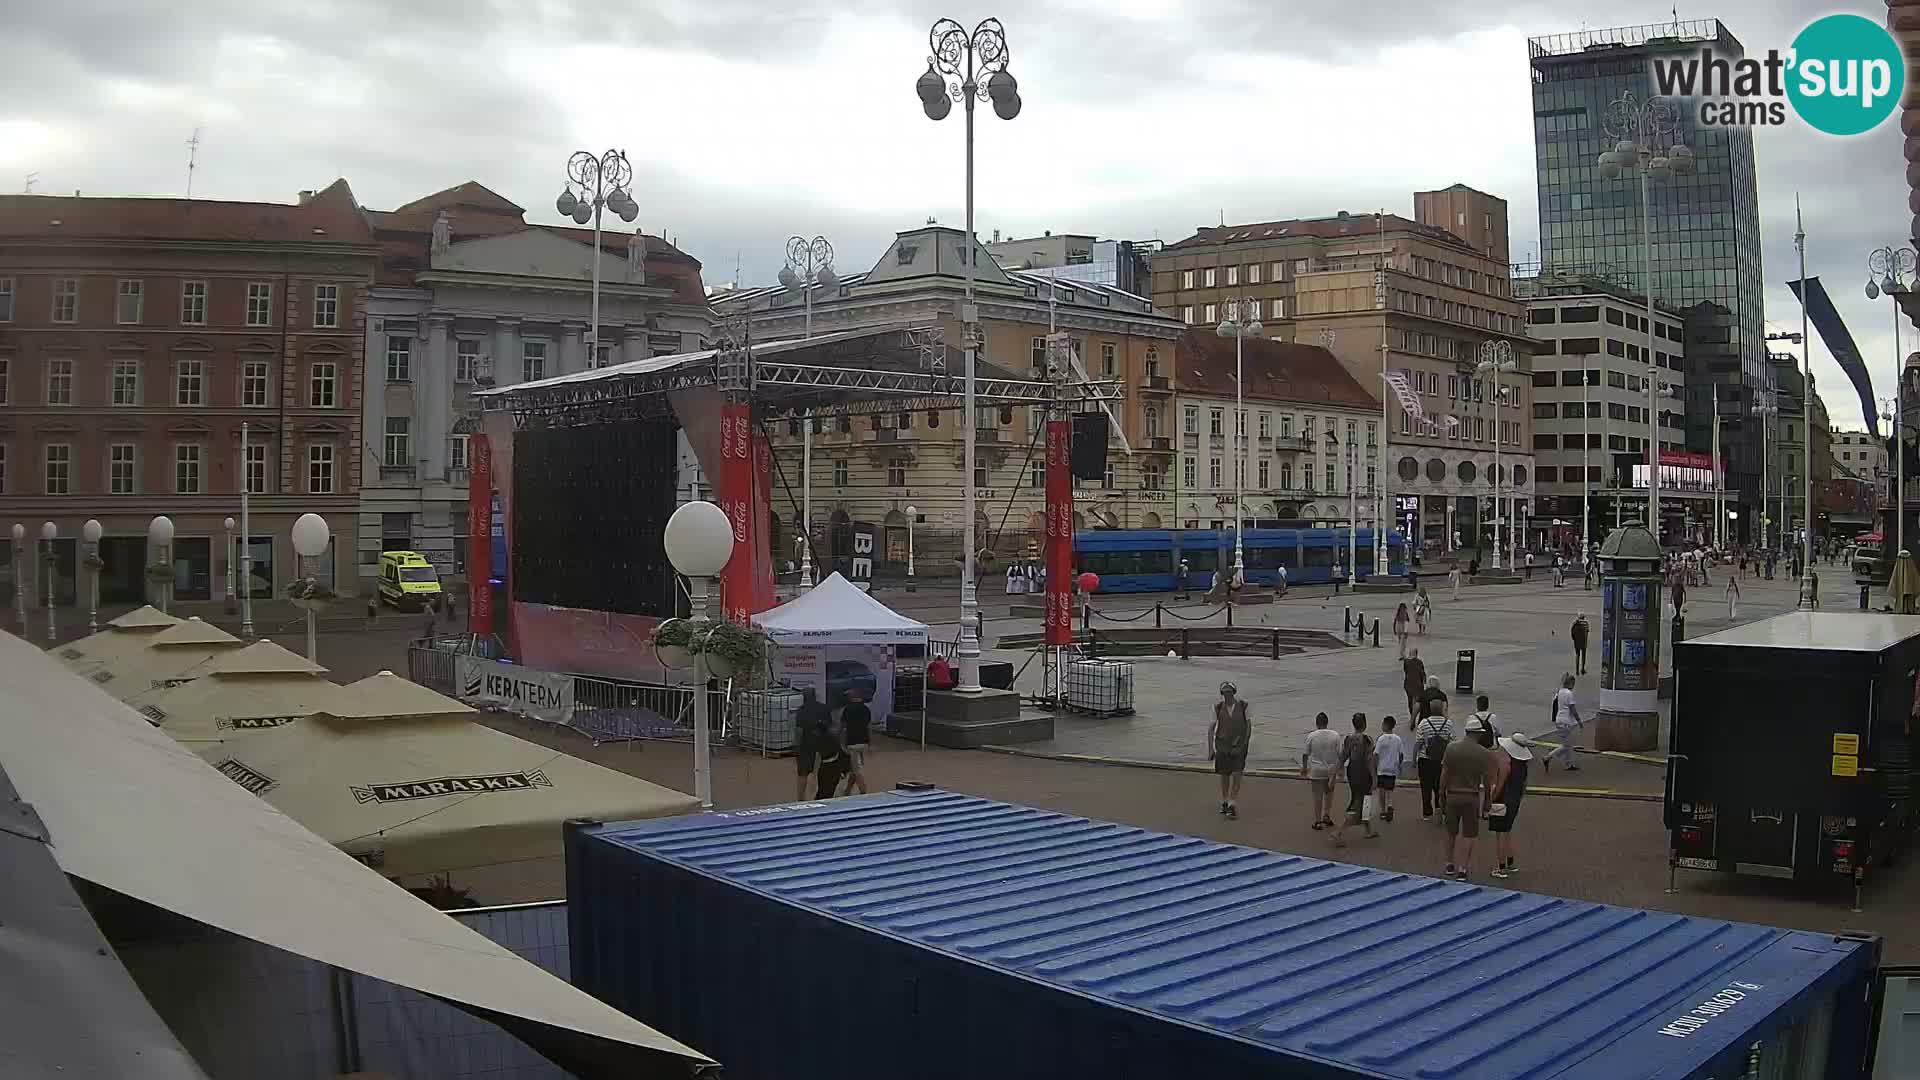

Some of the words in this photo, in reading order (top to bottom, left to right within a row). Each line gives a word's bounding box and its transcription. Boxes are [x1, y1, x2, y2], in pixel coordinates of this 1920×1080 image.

[735, 415, 748, 459] Coca-Cola
[735, 501, 748, 543] Coca-Cola
[1060, 503, 1070, 538] Coca-Cola
[1060, 591, 1070, 627] Coca-Cola
[486, 673, 562, 710] KERATERM
[383, 775, 525, 801] MARASKA
[1692, 988, 1748, 1018] 300629
